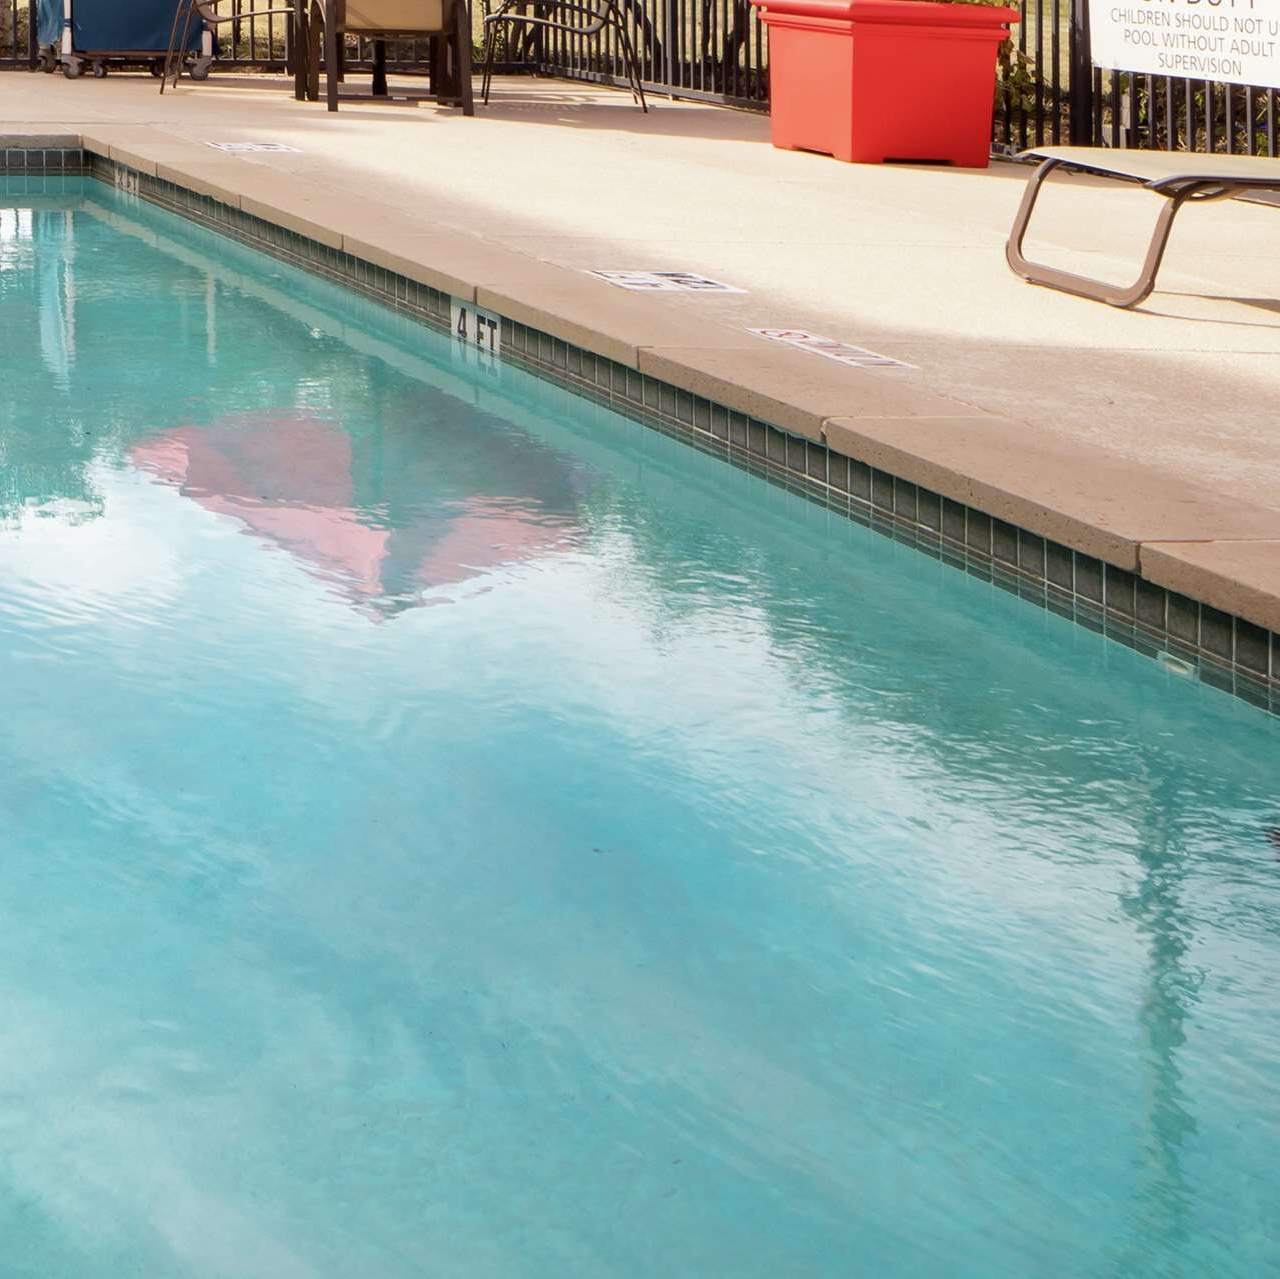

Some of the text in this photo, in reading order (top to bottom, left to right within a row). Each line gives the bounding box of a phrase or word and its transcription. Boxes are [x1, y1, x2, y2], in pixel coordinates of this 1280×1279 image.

[1111, 8, 1170, 27] CHILDREN
[1175, 12, 1229, 32] SHOULD
[1234, 18, 1263, 35] NOT
[1124, 29, 1276, 57] POOL WITHOUT ADULT
[1158, 53, 1241, 76] SUPERVISION
[457, 307, 497, 356] 4 FT
